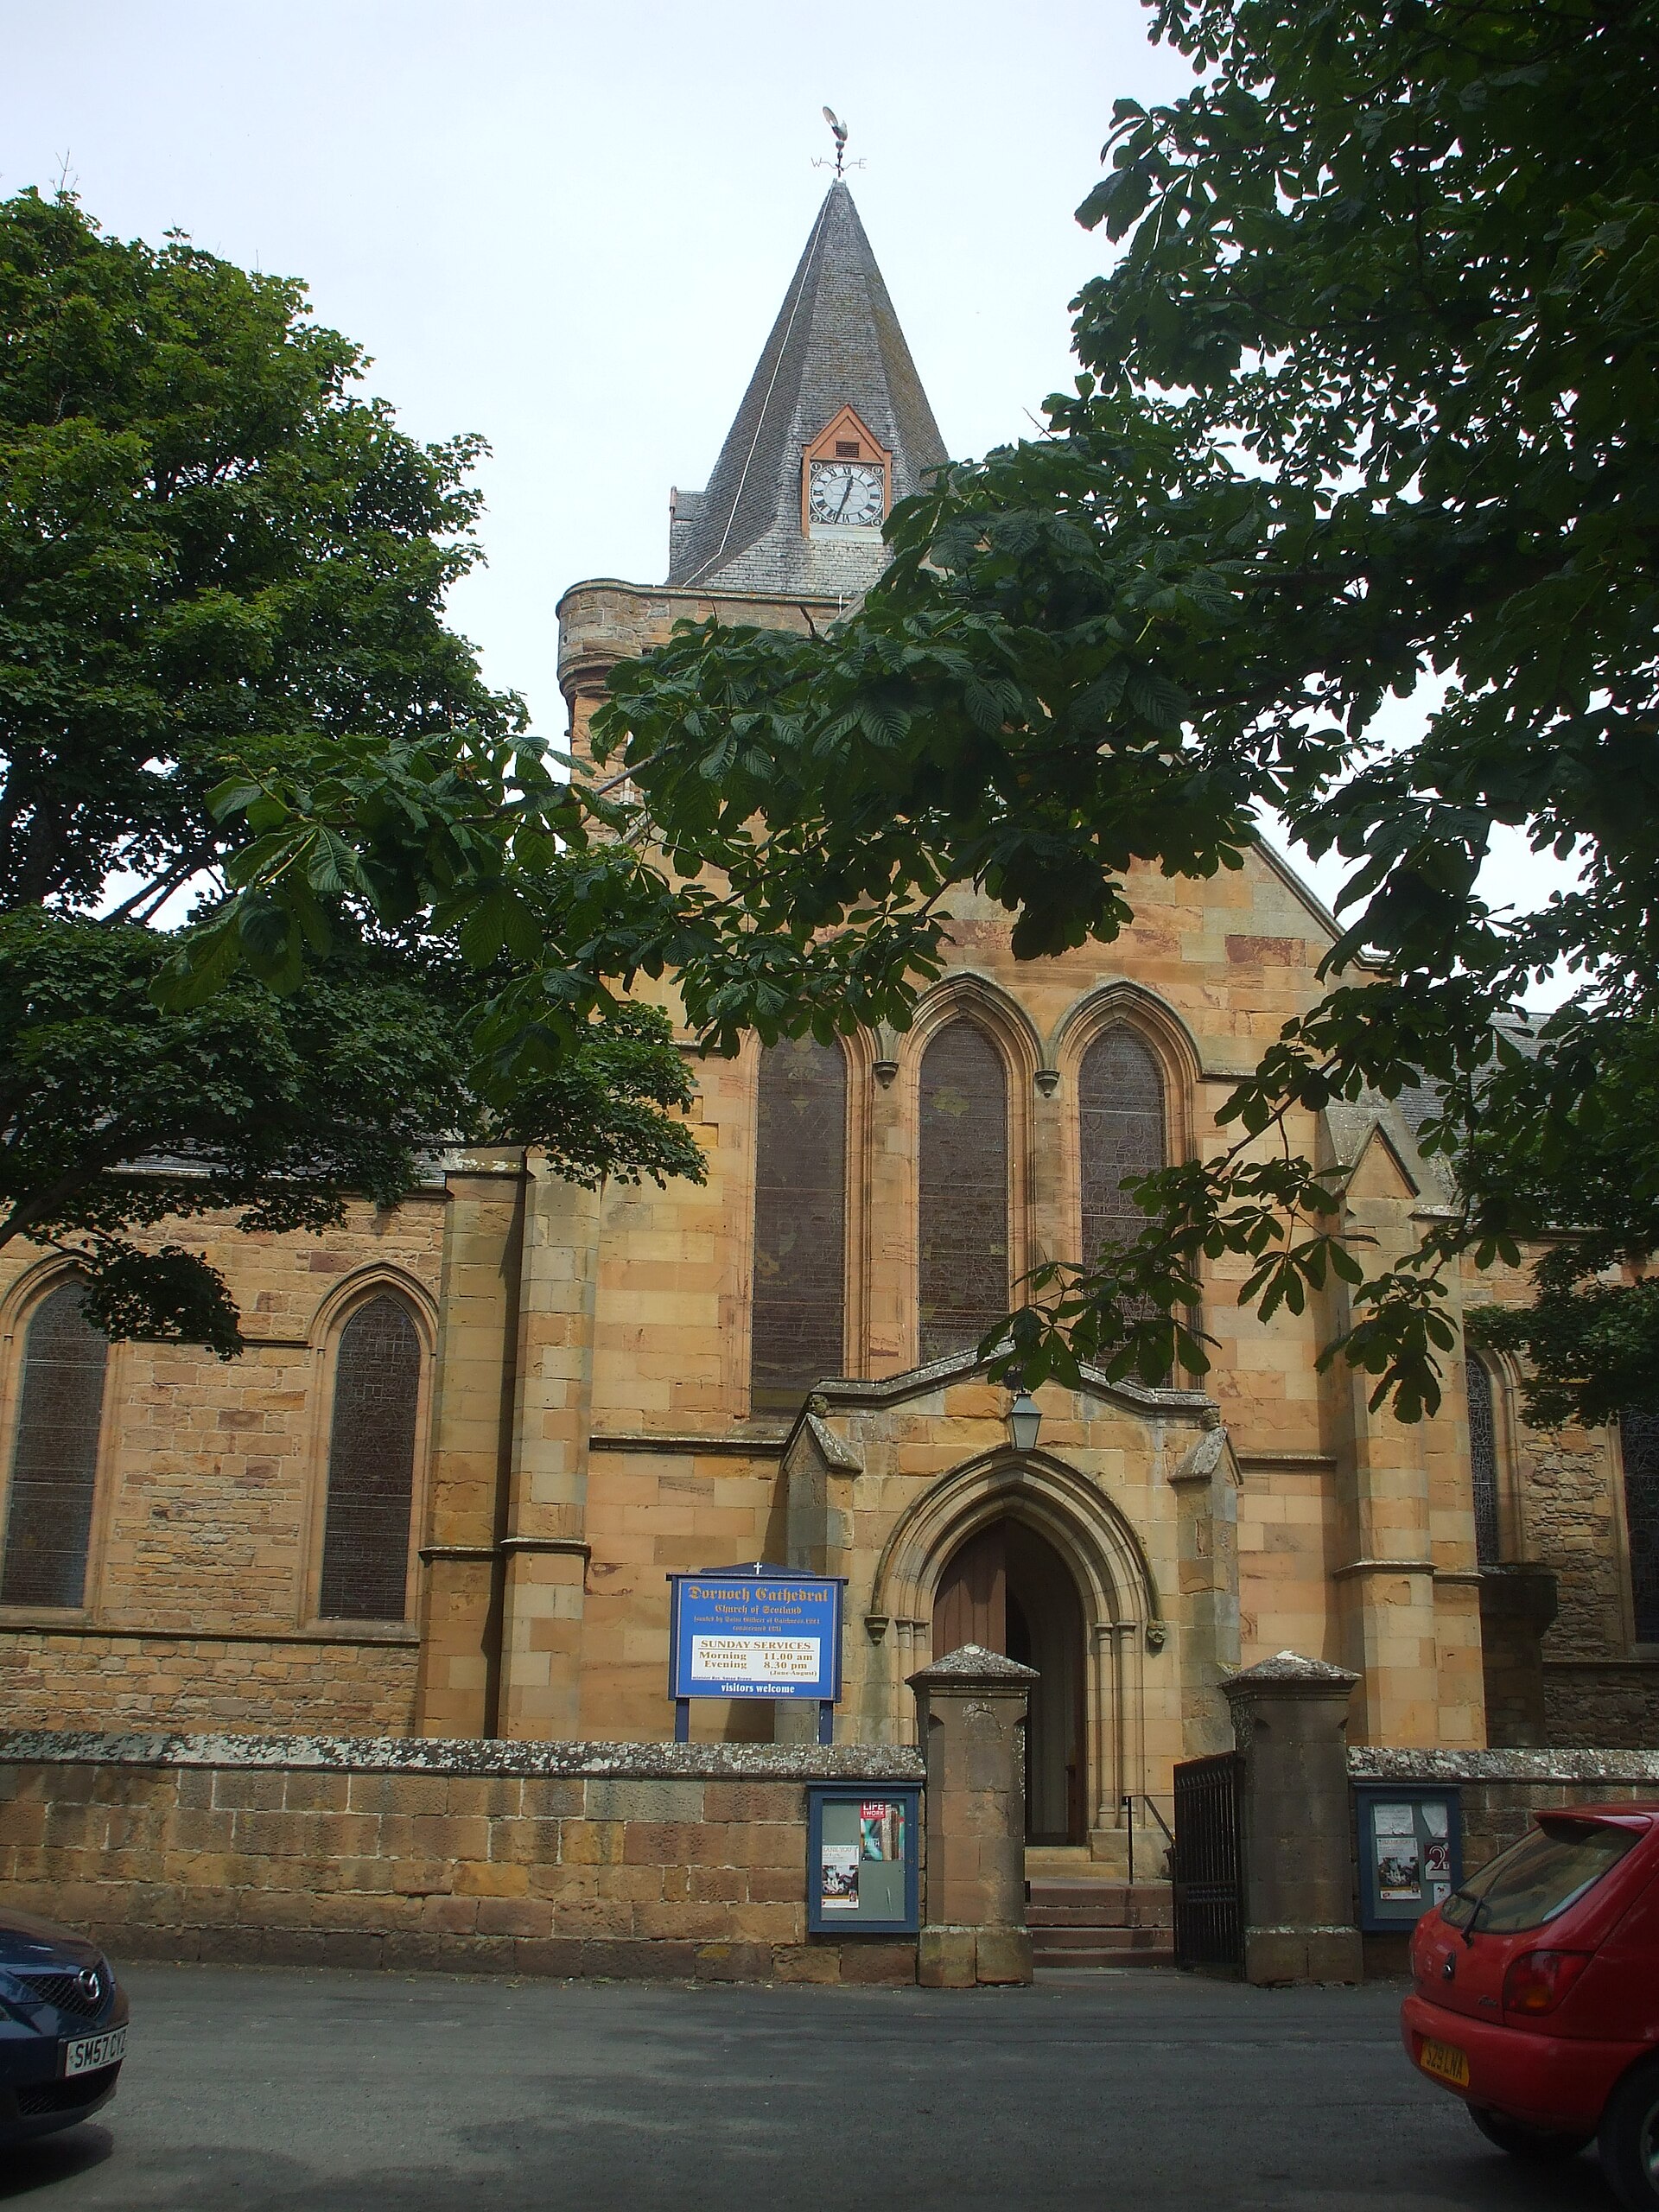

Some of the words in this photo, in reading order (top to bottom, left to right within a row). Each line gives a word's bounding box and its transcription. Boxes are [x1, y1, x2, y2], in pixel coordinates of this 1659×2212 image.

[688, 1586, 750, 1604] Dornoch
[755, 1586, 829, 1605] Cathedral
[715, 1605, 747, 1615] Church
[751, 1605, 760, 1615] of
[763, 1605, 802, 1616] Scotland
[701, 1640, 751, 1649] SUNDAY
[753, 1641, 811, 1650] SERVICES
[699, 1651, 747, 1661] Morning
[764, 1652, 793, 1661] 11.00
[704, 1661, 747, 1669] Evening
[764, 1661, 787, 1669] 8.30
[791, 1662, 808, 1671] pm
[721, 1682, 754, 1693] visitors
[756, 1683, 795, 1694] welcome
[863, 1801, 884, 1810] LIFE
[74, 2036, 110, 2068] SM57
